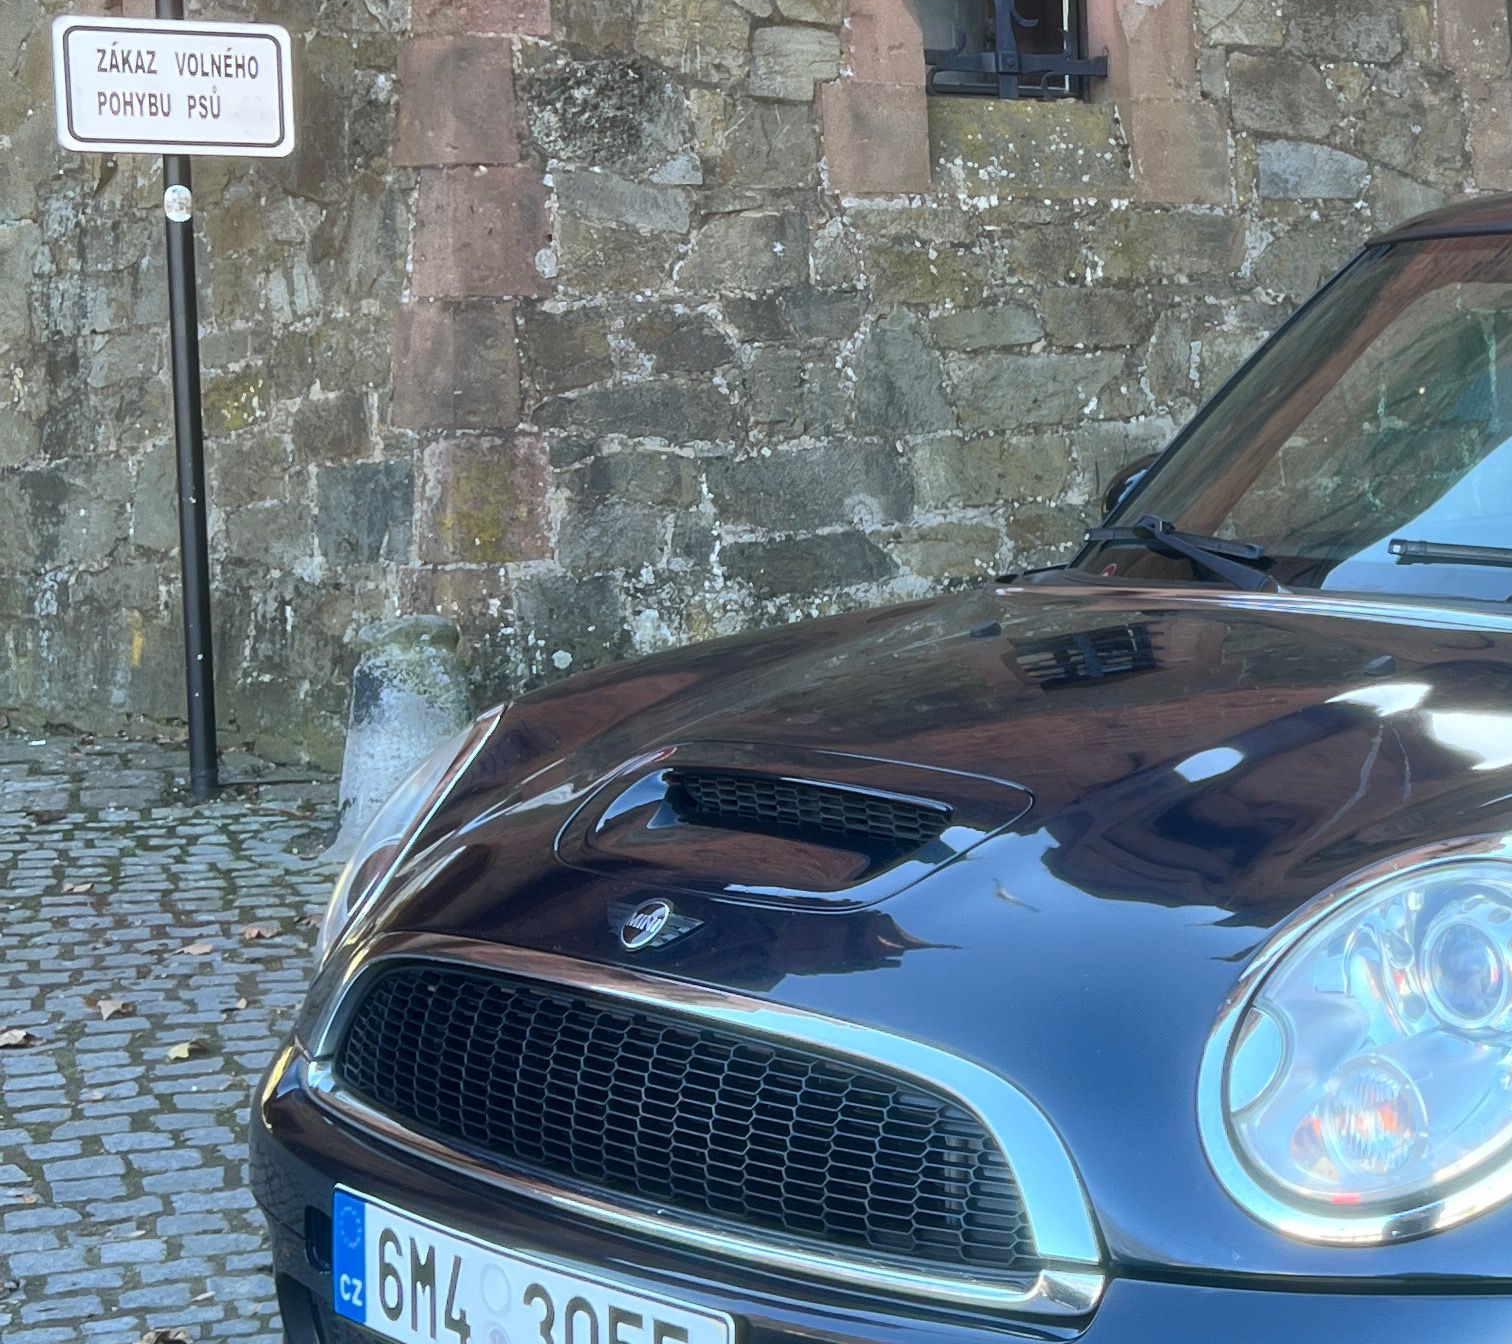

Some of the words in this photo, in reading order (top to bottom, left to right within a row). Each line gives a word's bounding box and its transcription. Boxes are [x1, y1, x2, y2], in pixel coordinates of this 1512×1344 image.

[96, 41, 157, 75] ZÁKAZ
[175, 47, 259, 79] VOLNÉHO
[96, 90, 172, 118] POHYBU
[186, 86, 222, 120] PSŮ
[339, 1272, 364, 1307] CZ
